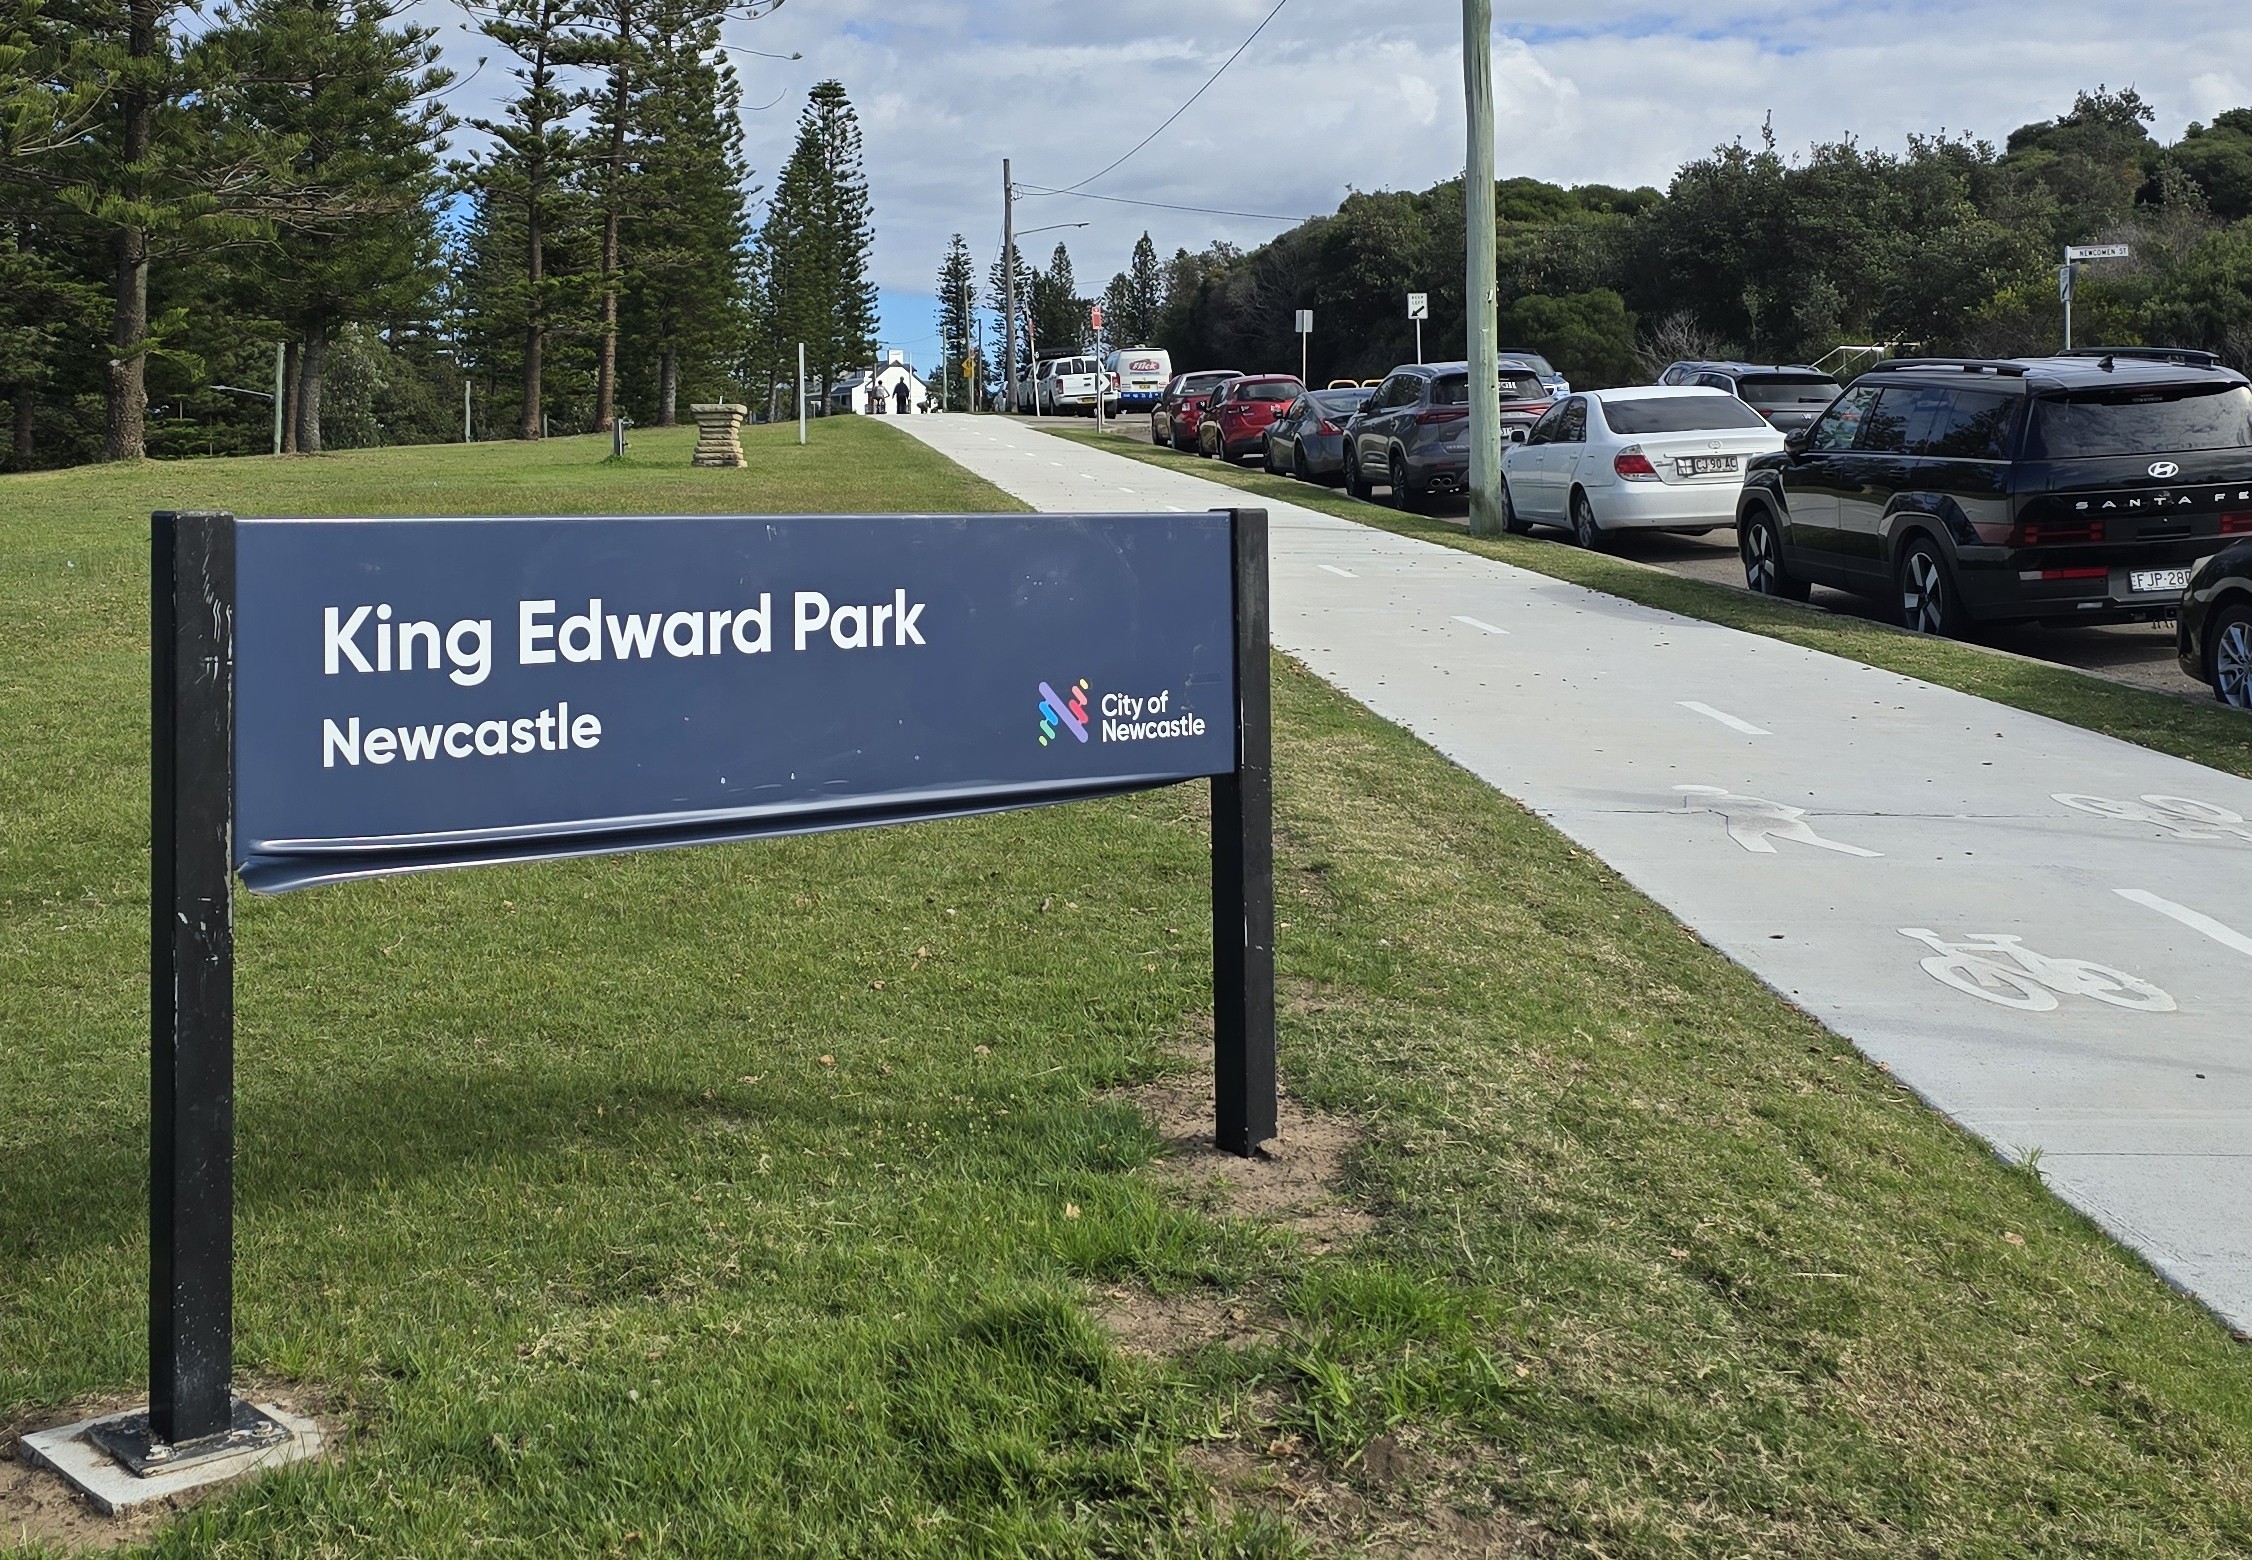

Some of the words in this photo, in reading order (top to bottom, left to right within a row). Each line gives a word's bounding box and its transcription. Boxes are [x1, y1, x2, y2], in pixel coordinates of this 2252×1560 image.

[2079, 248, 2116, 257] NEWCOMEN
[2119, 247, 2126, 255] ST
[1696, 458, 1708, 470] CJ
[1710, 458, 1722, 469] 90
[2075, 495, 2193, 510] SANTA
[2214, 490, 2250, 502] FE
[324, 603, 492, 687] King
[519, 592, 772, 665] Edward
[794, 588, 927, 653] Park
[1101, 692, 1144, 722] City
[1147, 689, 1169, 714] of
[323, 701, 602, 768] Newcastle
[1102, 713, 1206, 743] Newcastle
